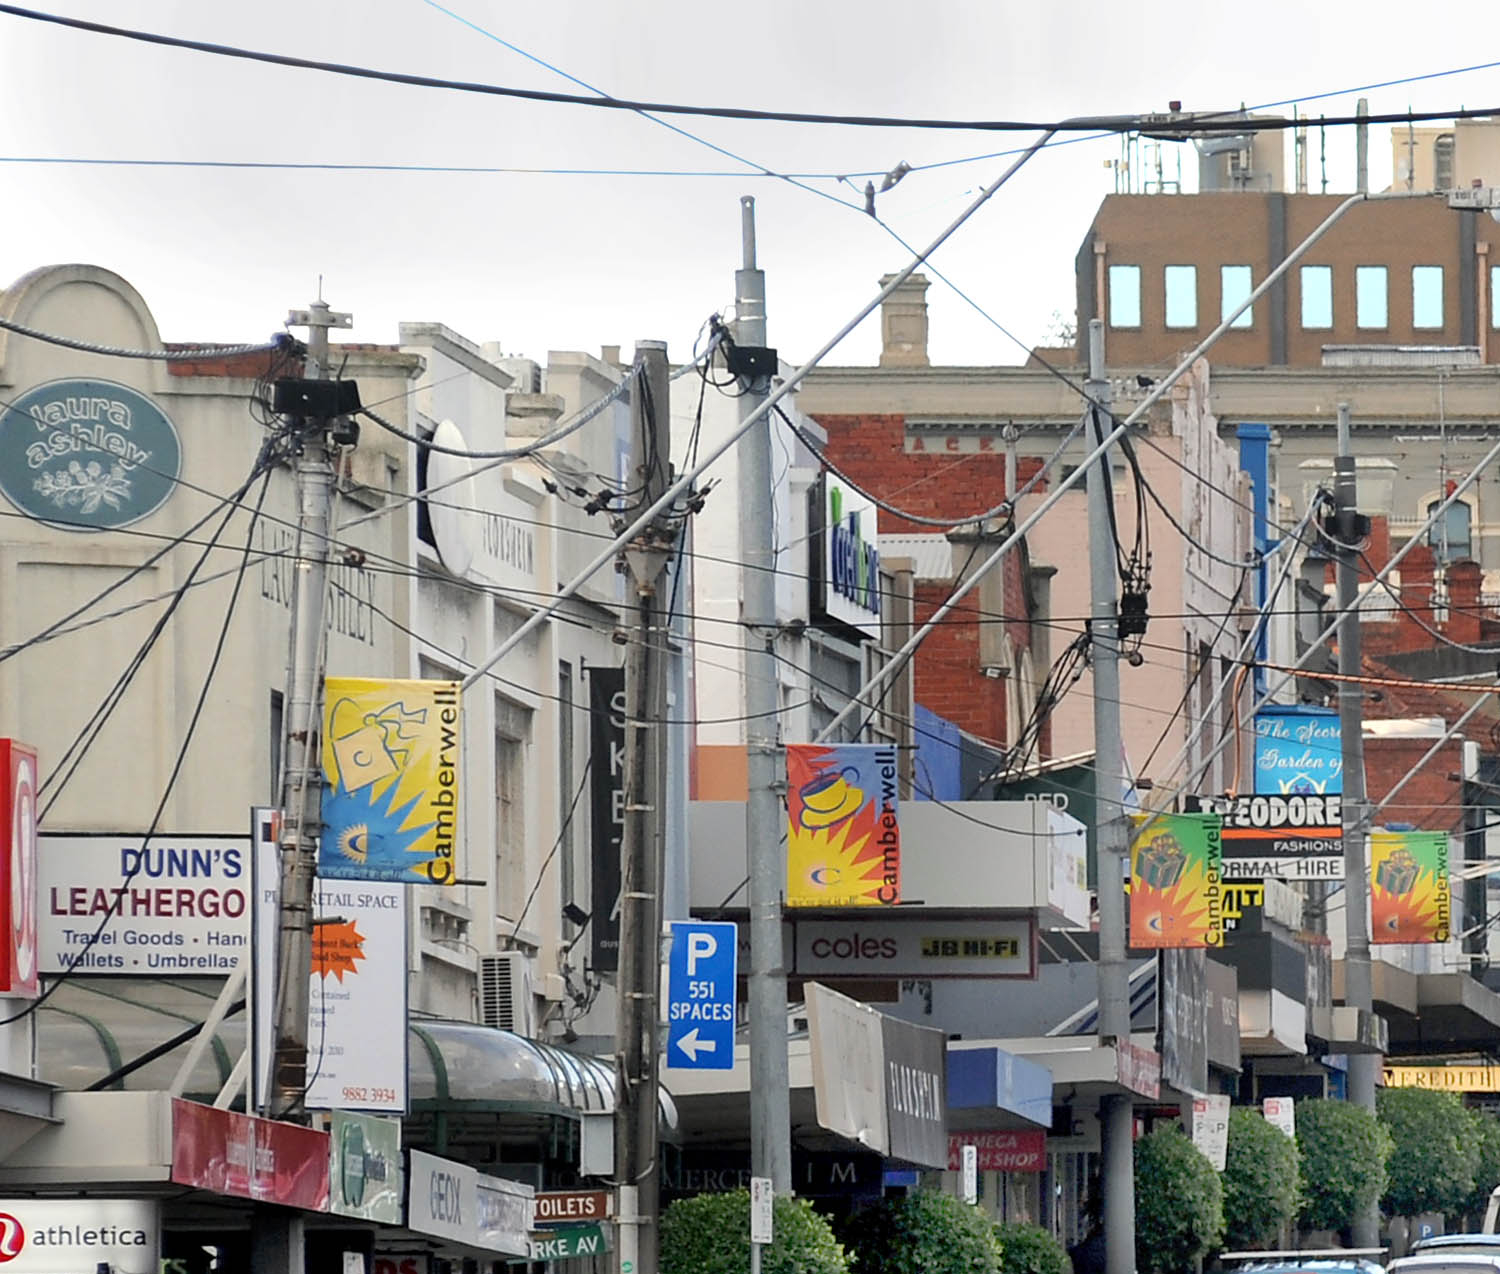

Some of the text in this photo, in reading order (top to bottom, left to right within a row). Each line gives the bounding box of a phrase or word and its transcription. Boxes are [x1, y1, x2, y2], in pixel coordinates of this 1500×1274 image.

[30, 397, 131, 431] laura
[26, 423, 149, 470] ashley
[1257, 748, 1323, 771] Garden
[426, 680, 460, 886] Camberwell.
[875, 744, 898, 905] Camberwell.
[1273, 841, 1342, 852] FASHIONS
[121, 848, 242, 878] DUNN'S
[1297, 859, 1340, 875] HIRE
[50, 887, 246, 917] LEATHERGO
[357, 894, 398, 909] SPACE
[63, 930, 117, 945] Travel
[123, 930, 184, 946] Goods
[811, 933, 898, 959] coles
[687, 932, 717, 976] P
[922, 940, 958, 957] JB
[57, 953, 238, 969] Wallets Umbrellas
[689, 981, 715, 999] 551
[670, 1002, 732, 1021] SPACES
[1383, 1069, 1491, 1087] MEREDITH
[342, 1087, 396, 1103] 9882 3934
[993, 1153, 1039, 1167] SHOP
[430, 1169, 462, 1225] GEOX
[534, 1196, 596, 1217] TOILETS
[32, 1225, 147, 1246] athletica
[576, 1235, 599, 1253] AV
